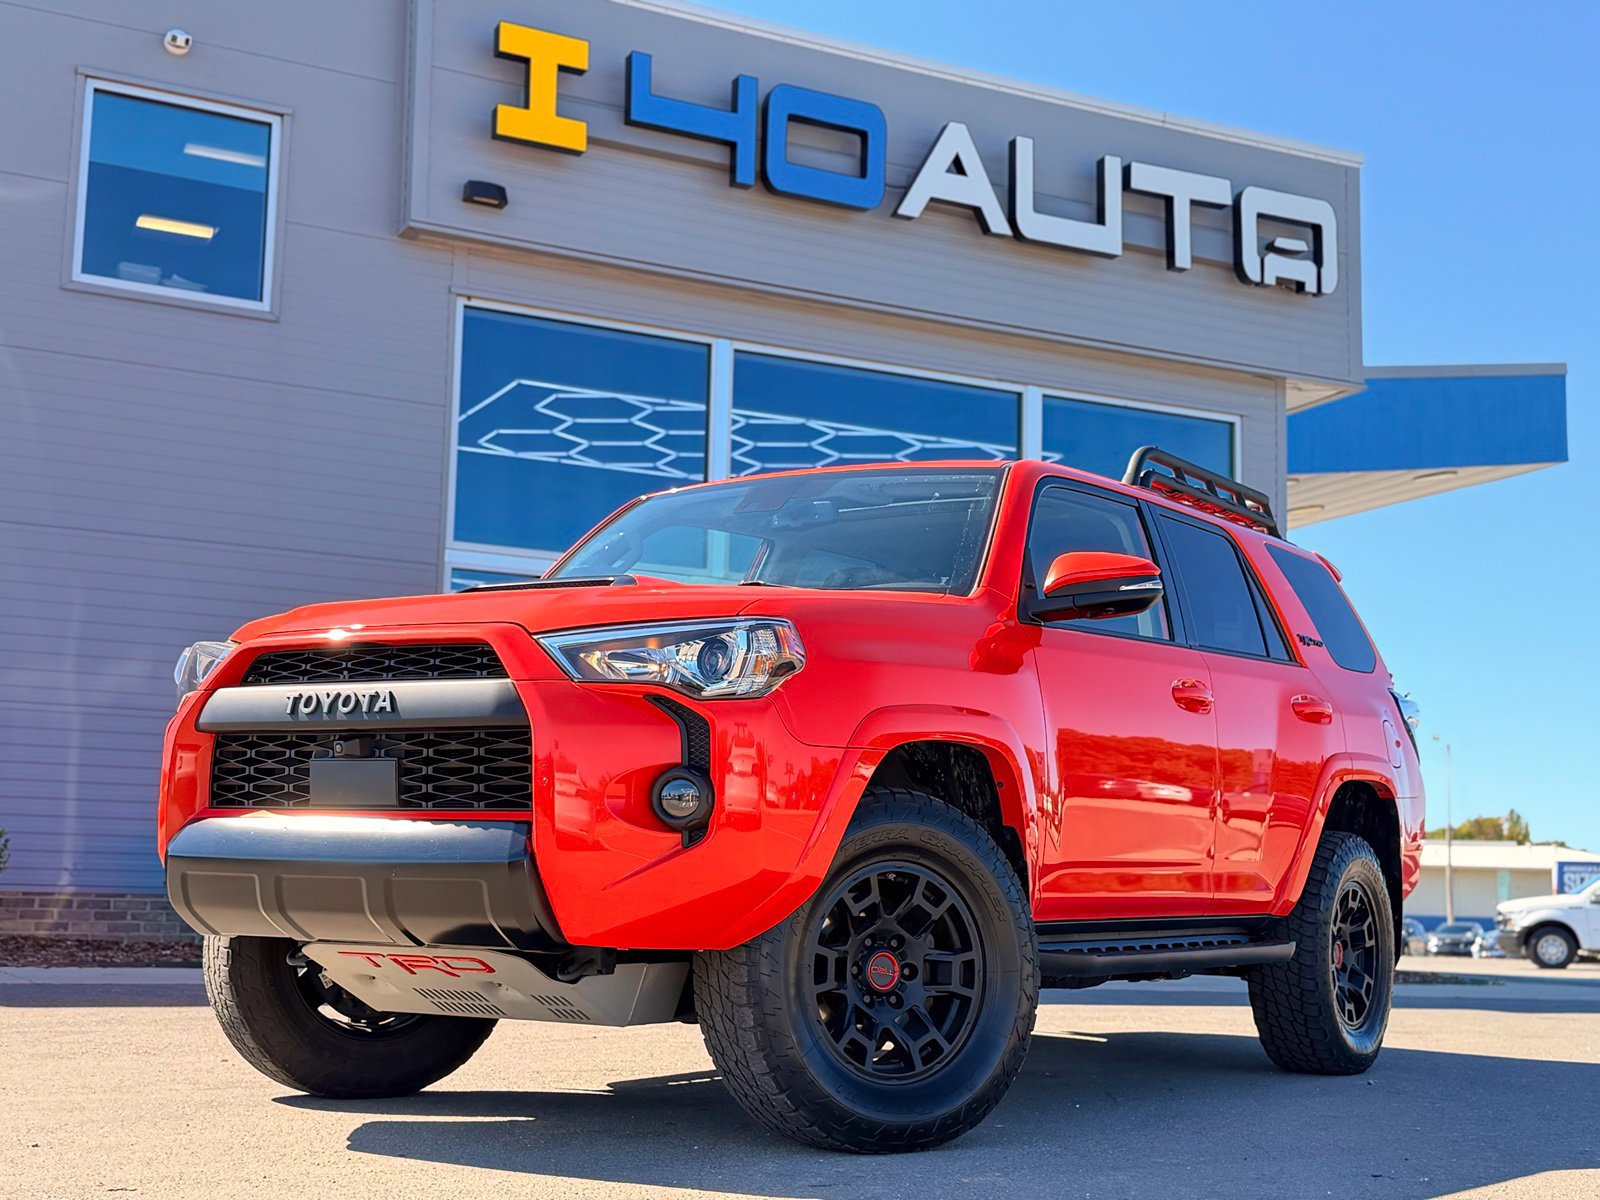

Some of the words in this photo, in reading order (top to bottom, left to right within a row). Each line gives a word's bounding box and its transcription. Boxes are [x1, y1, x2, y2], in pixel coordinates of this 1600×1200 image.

[286, 690, 393, 714] TOYOTA
[841, 829, 909, 857] TERRA
[920, 831, 1008, 922] GRAPPLER
[337, 951, 496, 978] TRD
